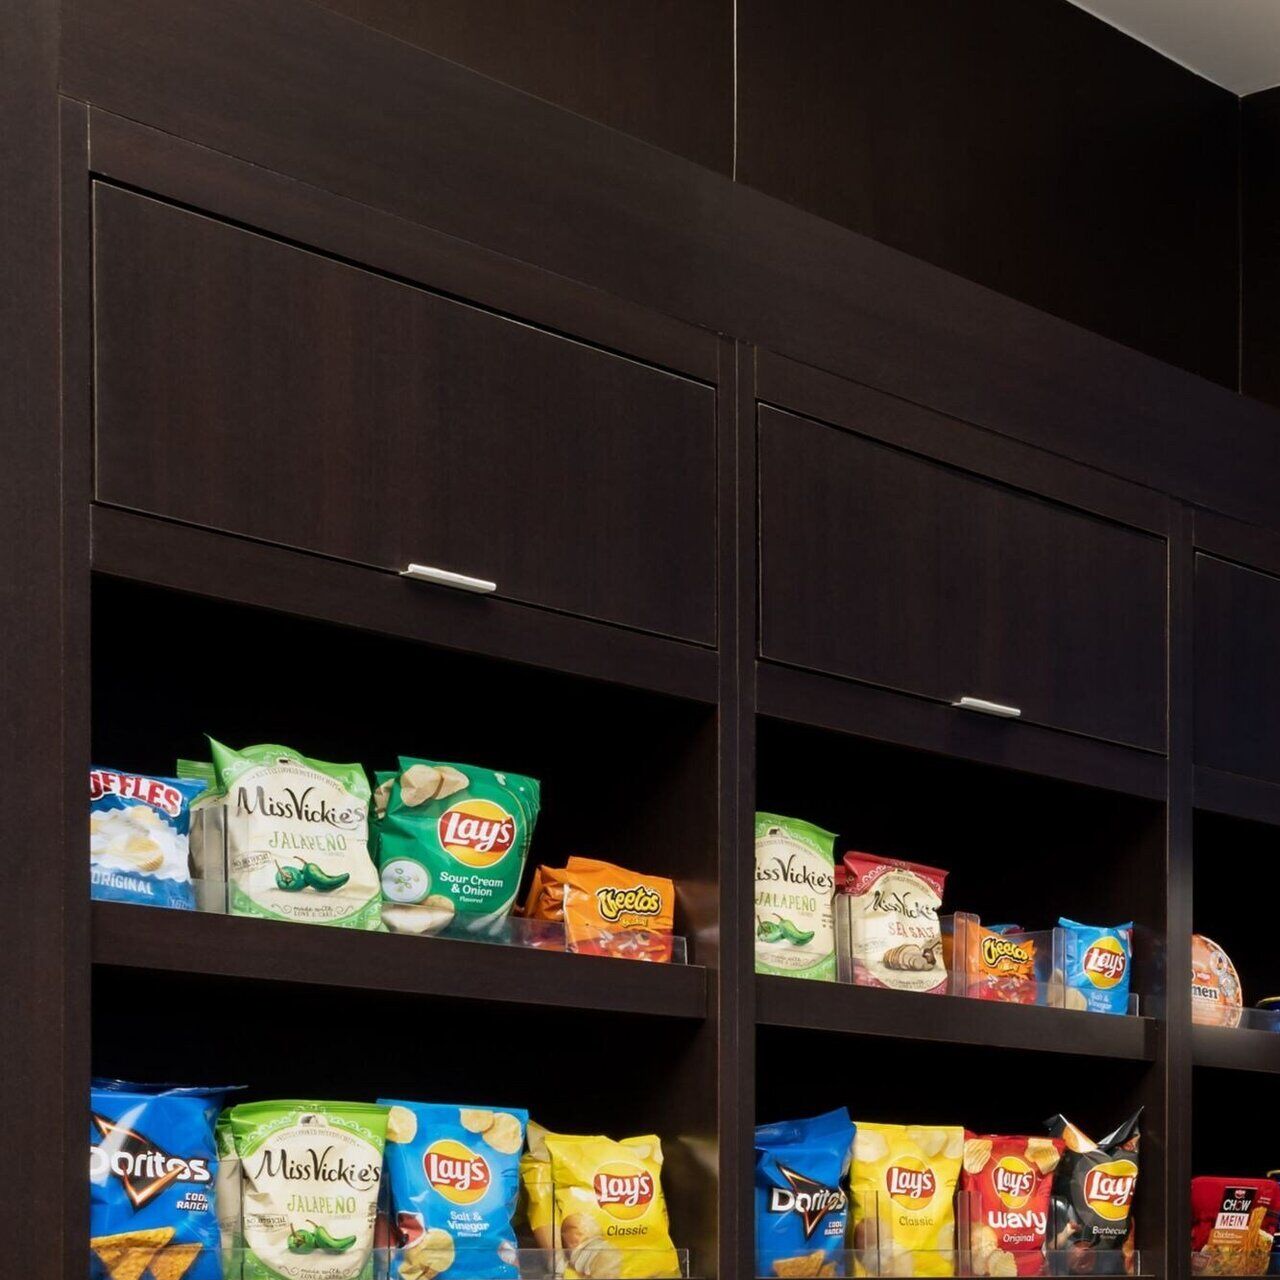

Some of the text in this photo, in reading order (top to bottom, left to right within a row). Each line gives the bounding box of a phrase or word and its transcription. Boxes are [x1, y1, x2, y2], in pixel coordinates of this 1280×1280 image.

[90, 771, 182, 817] UFFLES
[444, 812, 513, 851] Lay's
[440, 871, 503, 888] Sour Cream
[755, 868, 779, 883] iss
[452, 884, 492, 898] & Onion
[598, 886, 661, 923] Cheetos
[1088, 949, 1125, 978] Lay's
[1192, 984, 1218, 999] men
[430, 1153, 487, 1190] Lay's
[891, 1167, 933, 1198] Lay's
[997, 1168, 1030, 1196] Lay's
[599, 1173, 649, 1207] Lay's
[772, 1188, 847, 1213] Doritos
[177, 1201, 208, 1212] RANCH
[607, 1225, 648, 1237] Classic
[899, 1215, 934, 1226] Classic
[989, 1210, 1047, 1234] wavy
[1221, 1214, 1245, 1226] MEIN
[1003, 1233, 1034, 1244] Original
